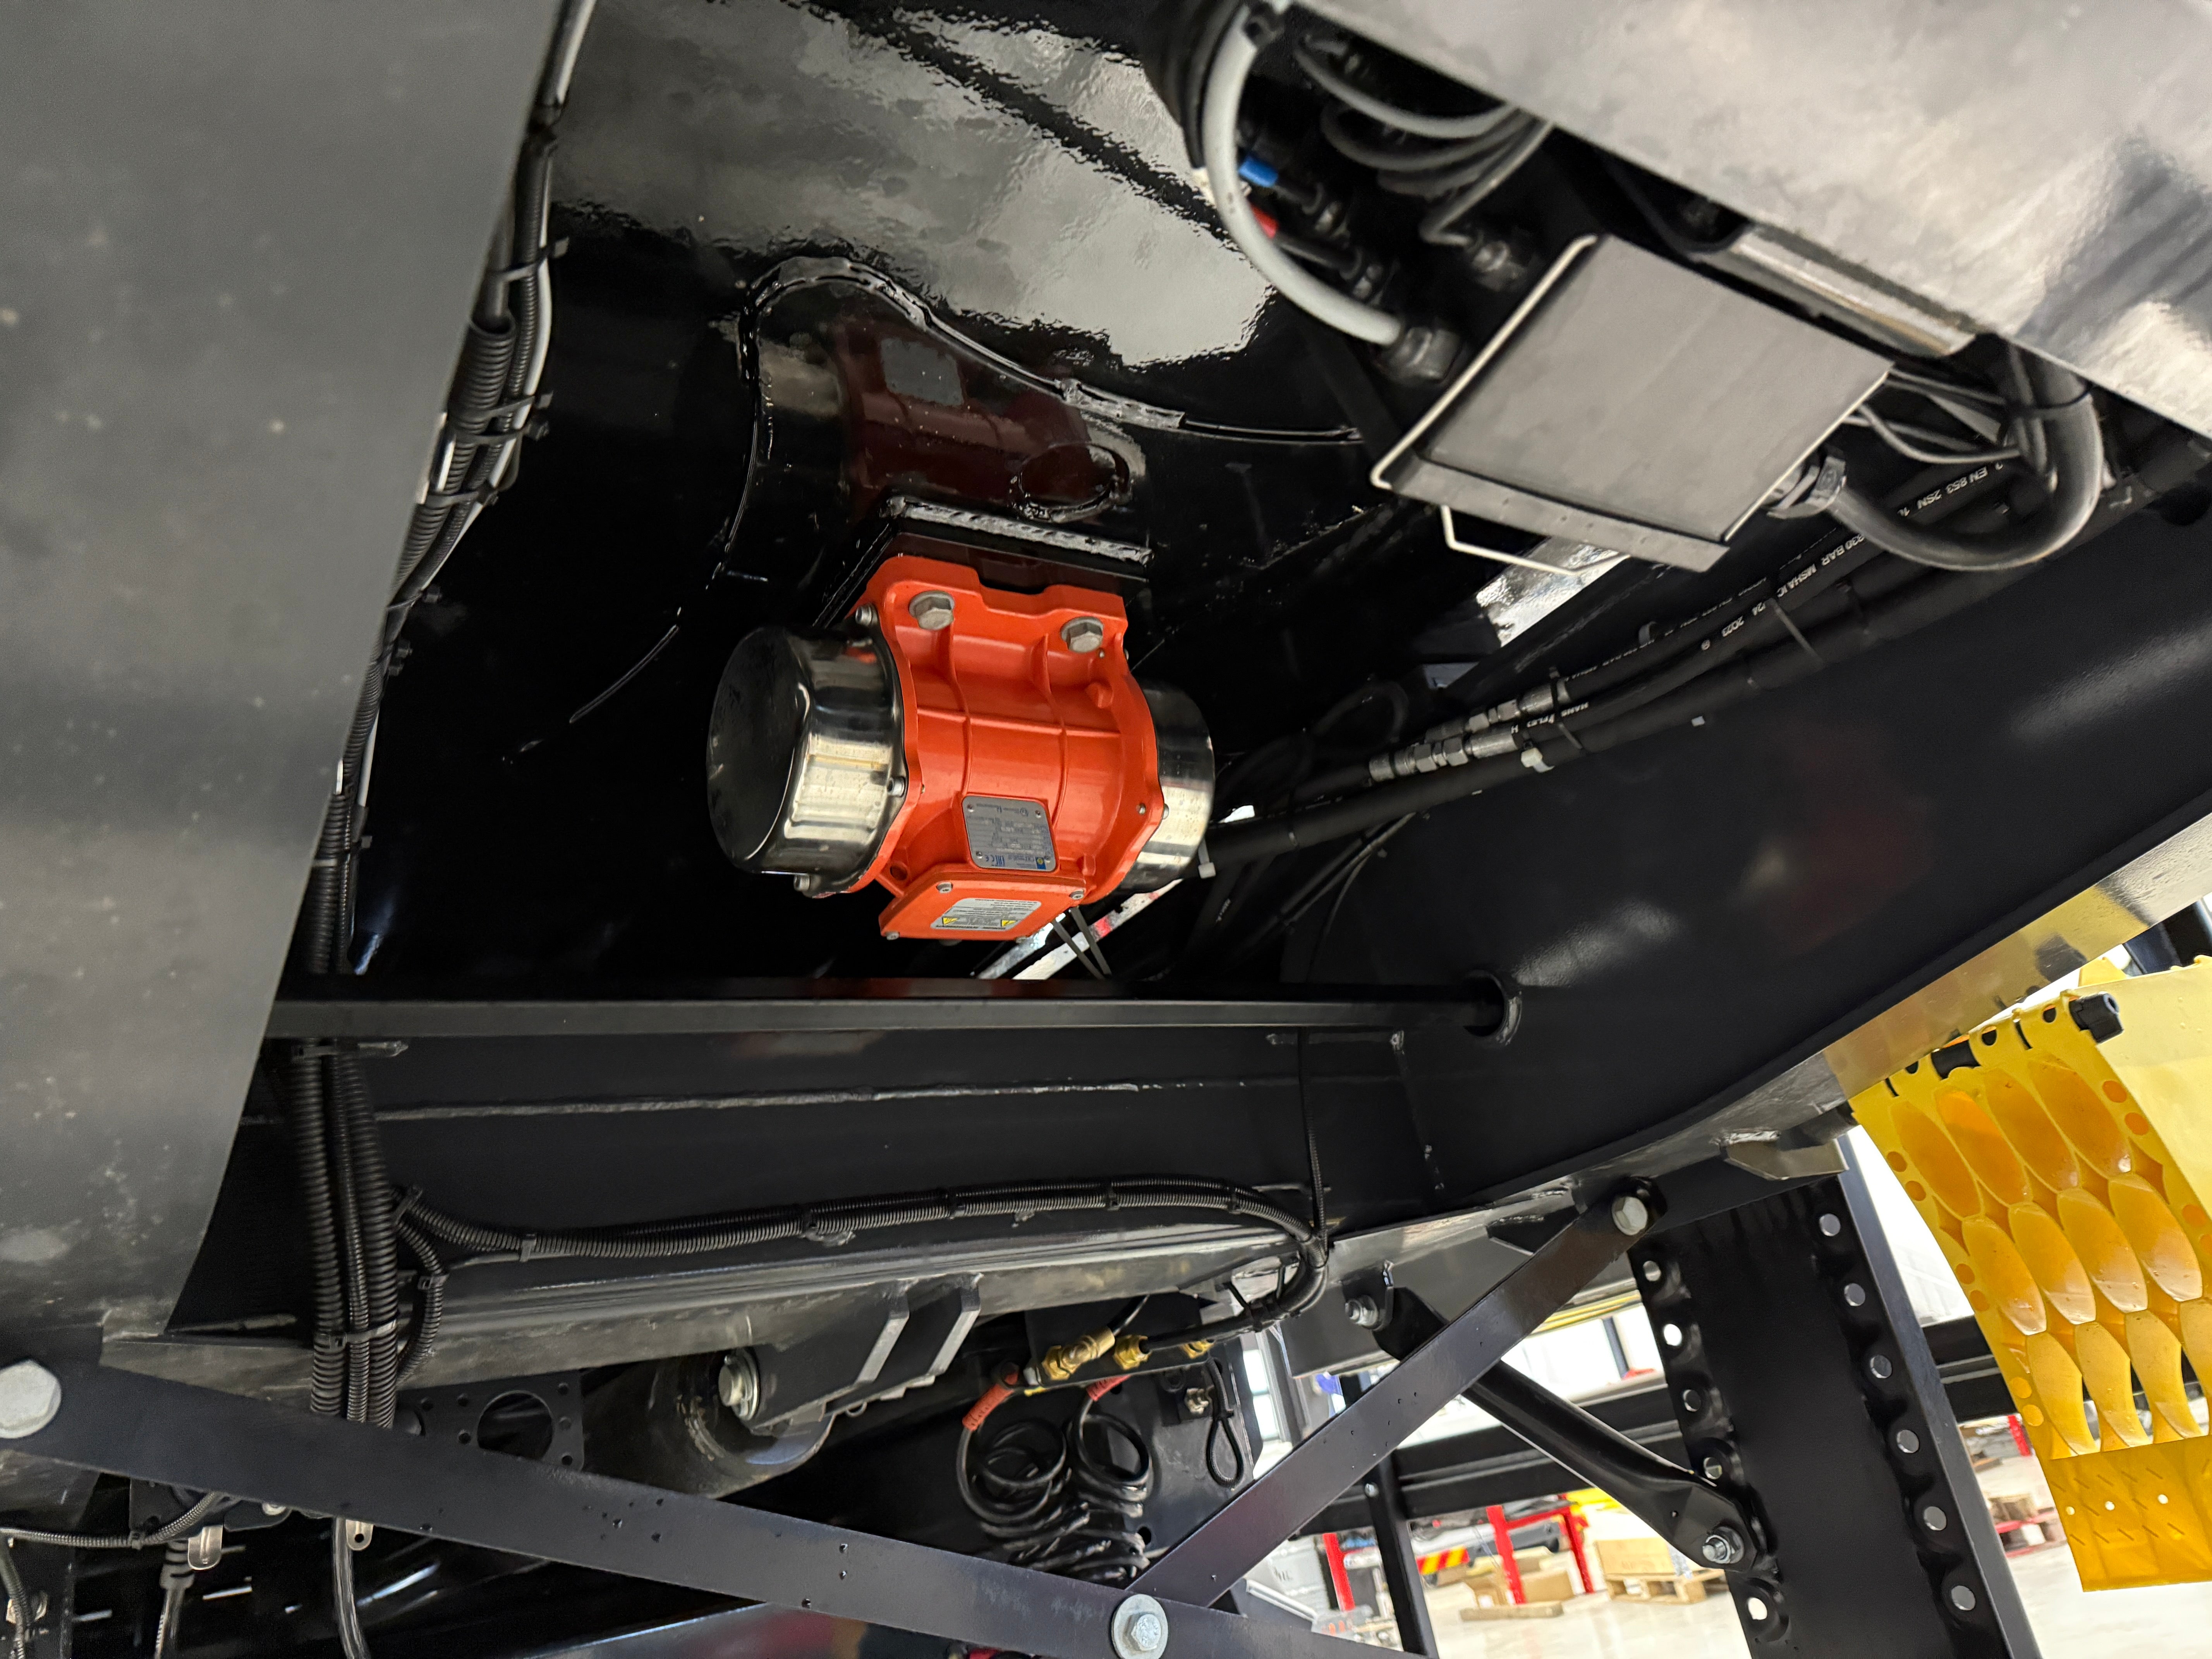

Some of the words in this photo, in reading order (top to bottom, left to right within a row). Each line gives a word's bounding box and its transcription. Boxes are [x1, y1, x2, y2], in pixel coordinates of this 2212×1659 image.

[1969, 466, 1988, 483] EN
[1945, 477, 1968, 494] 853
[1917, 489, 1942, 509] 2SN
[1821, 545, 1845, 566] BAR
[1787, 563, 1817, 589] MSHA
